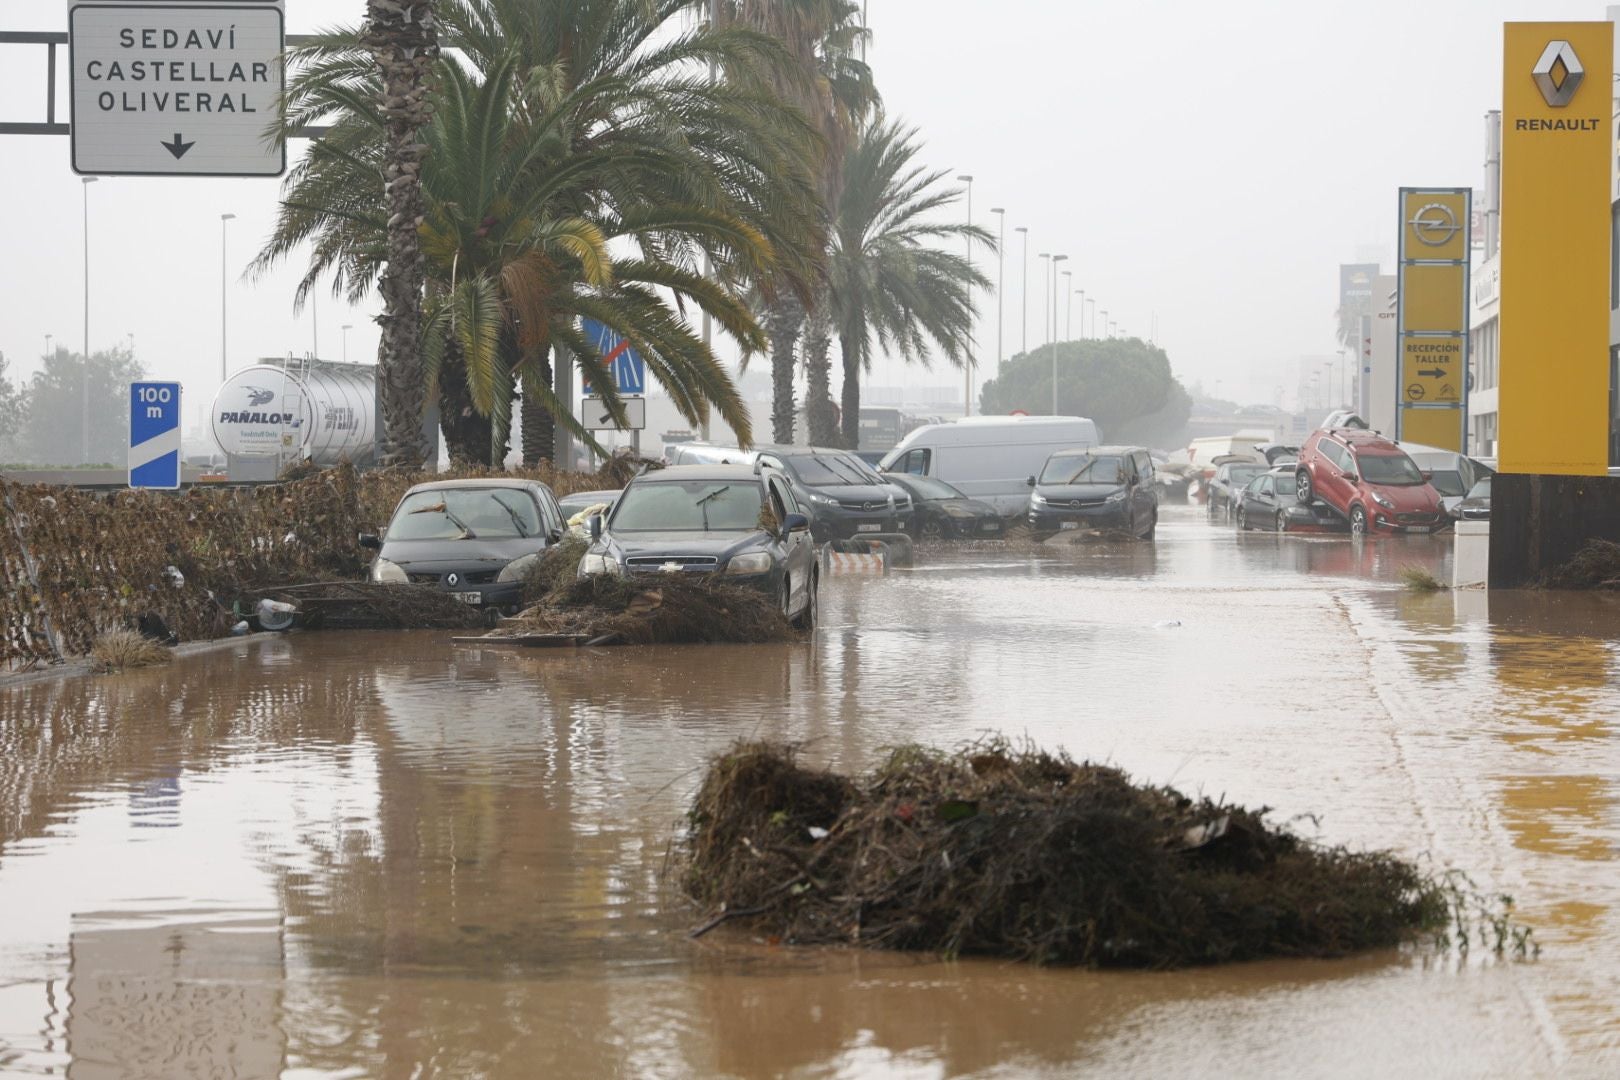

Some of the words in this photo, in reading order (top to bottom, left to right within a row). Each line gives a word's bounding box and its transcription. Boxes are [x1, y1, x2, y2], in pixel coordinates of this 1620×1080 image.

[119, 25, 236, 50] SEDAVÍ
[86, 60, 269, 83] CASTELLAR
[98, 91, 257, 113] OLIVERAL
[1515, 119, 1600, 131] RENAULT
[1406, 341, 1460, 353] RECEPCIÓN
[1415, 355, 1450, 363] TALLER
[138, 387, 171, 403] 100
[146, 406, 162, 418] m
